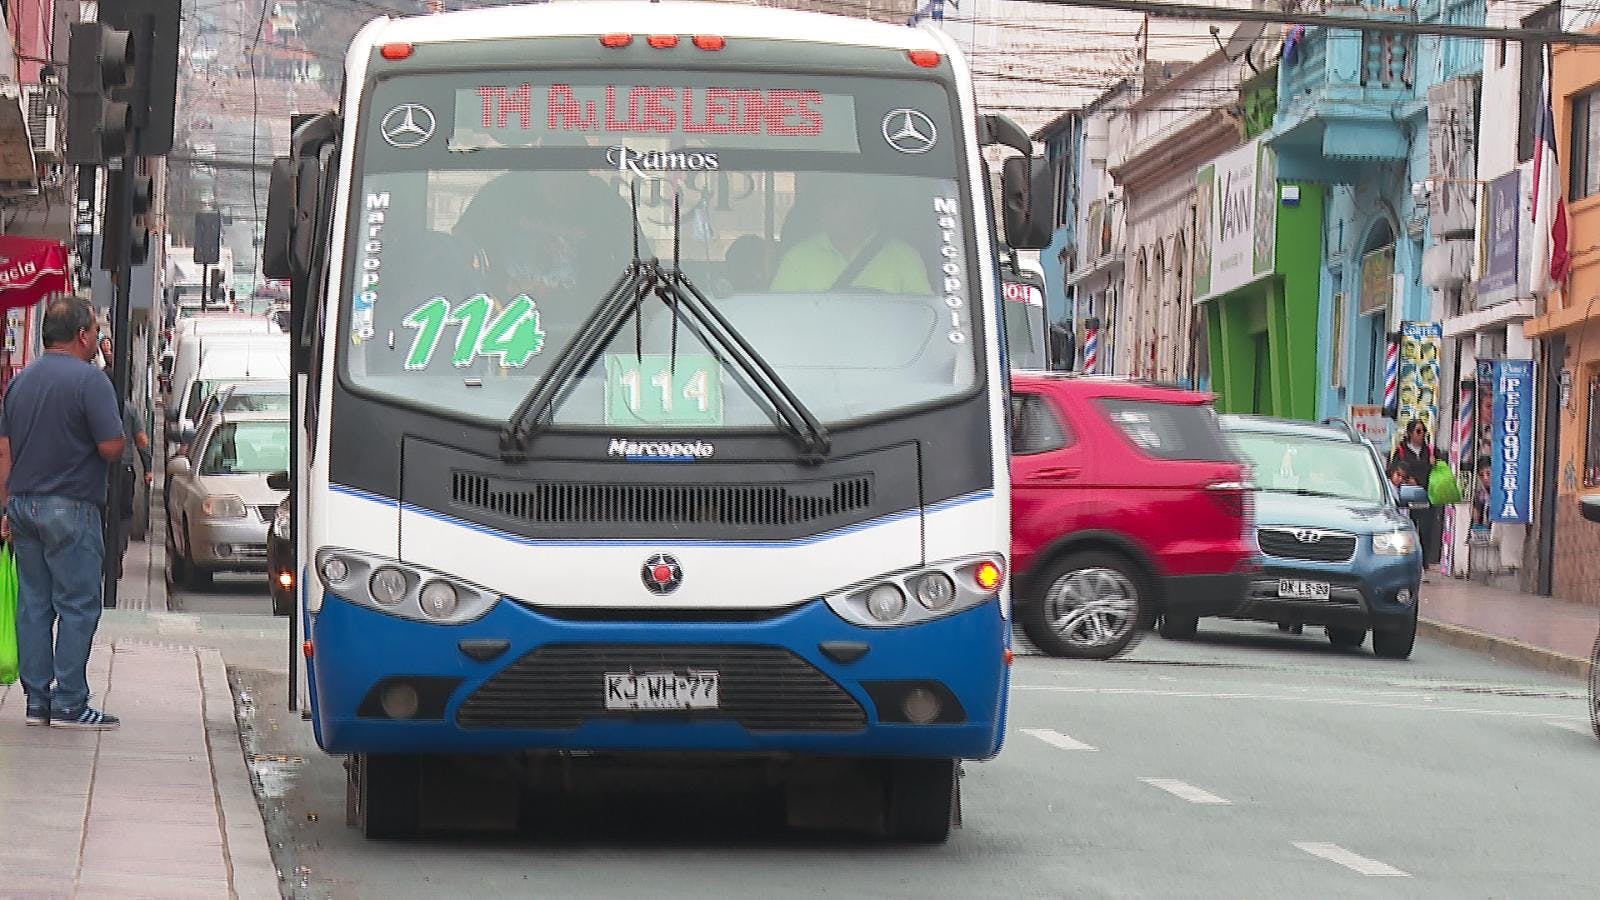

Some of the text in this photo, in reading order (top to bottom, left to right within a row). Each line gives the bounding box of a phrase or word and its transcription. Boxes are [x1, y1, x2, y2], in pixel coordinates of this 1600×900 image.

[605, 83, 677, 133] LOS
[682, 86, 824, 137] LEONES
[606, 145, 720, 181] Ramos
[933, 197, 967, 344] Marcopolo
[402, 293, 546, 370] 114
[618, 367, 710, 413] 114
[606, 437, 716, 458] Marcopolo
